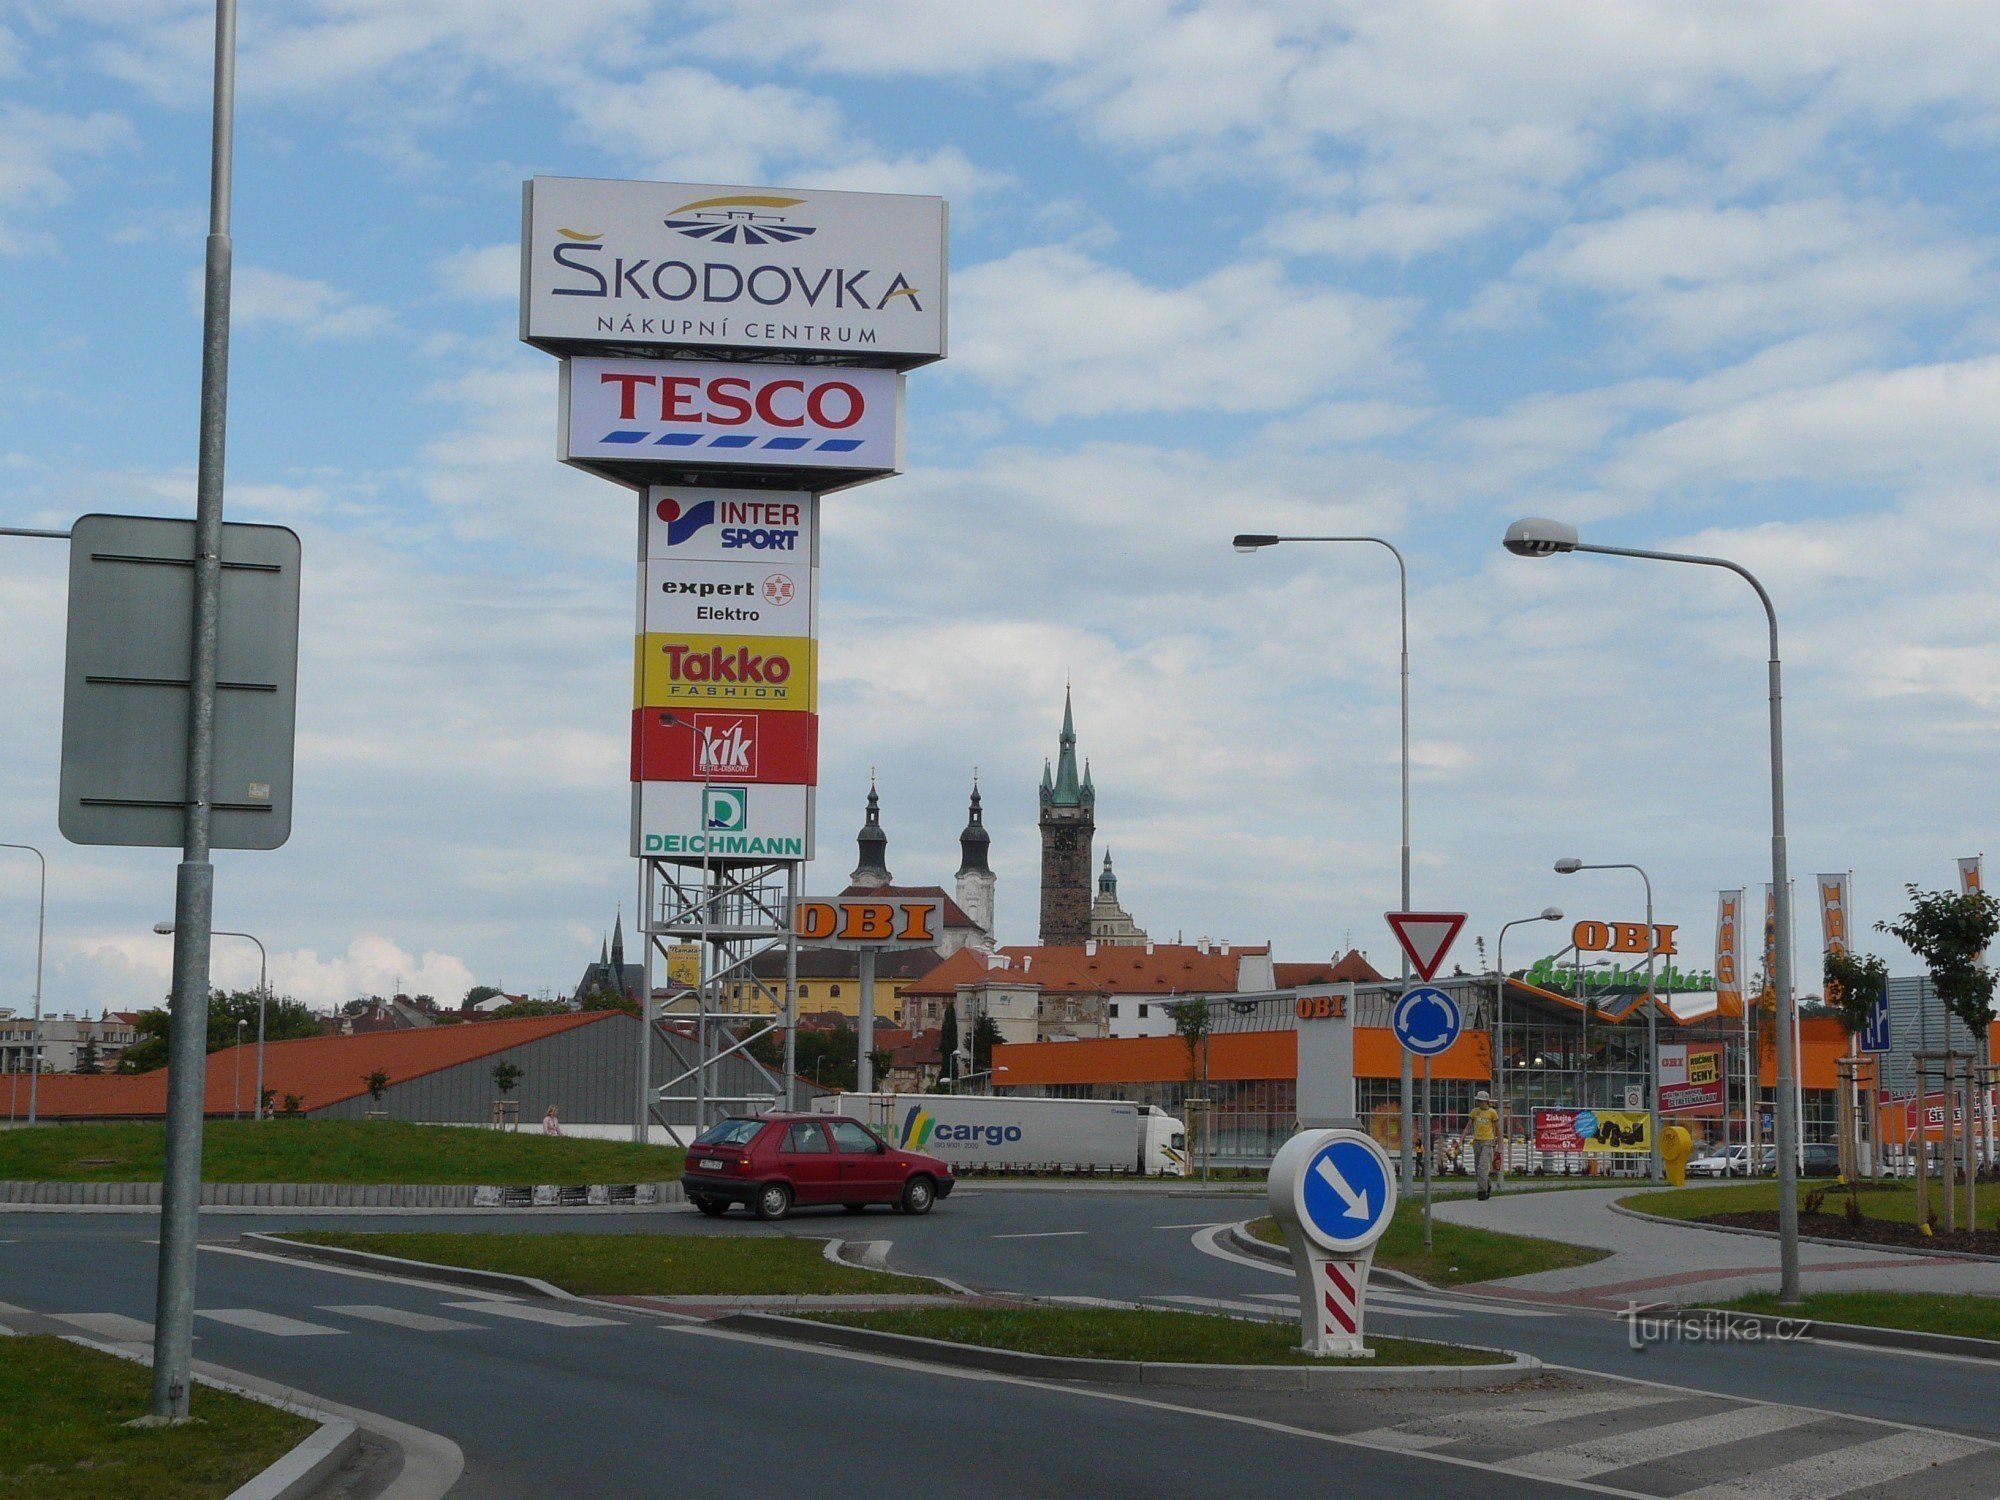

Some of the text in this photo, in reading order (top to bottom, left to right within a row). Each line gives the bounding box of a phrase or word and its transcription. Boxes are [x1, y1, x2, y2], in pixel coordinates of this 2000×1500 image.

[551, 229, 923, 312] ŠKODOVKA
[597, 313, 877, 344] NÁKUPNÍ CENTRUM
[600, 373, 866, 430] TESCO
[721, 501, 800, 526] INTER
[720, 528, 799, 550] SPORT
[662, 581, 755, 597] expert
[696, 606, 760, 622] Elektro
[662, 643, 791, 684] Takko
[670, 686, 786, 698] FASHION
[645, 834, 802, 855] DEICHMANN
[796, 903, 936, 940] OBI
[1572, 920, 1679, 955] OBI
[1297, 995, 1346, 1018] OBI
[934, 1124, 1022, 1146] cargo
